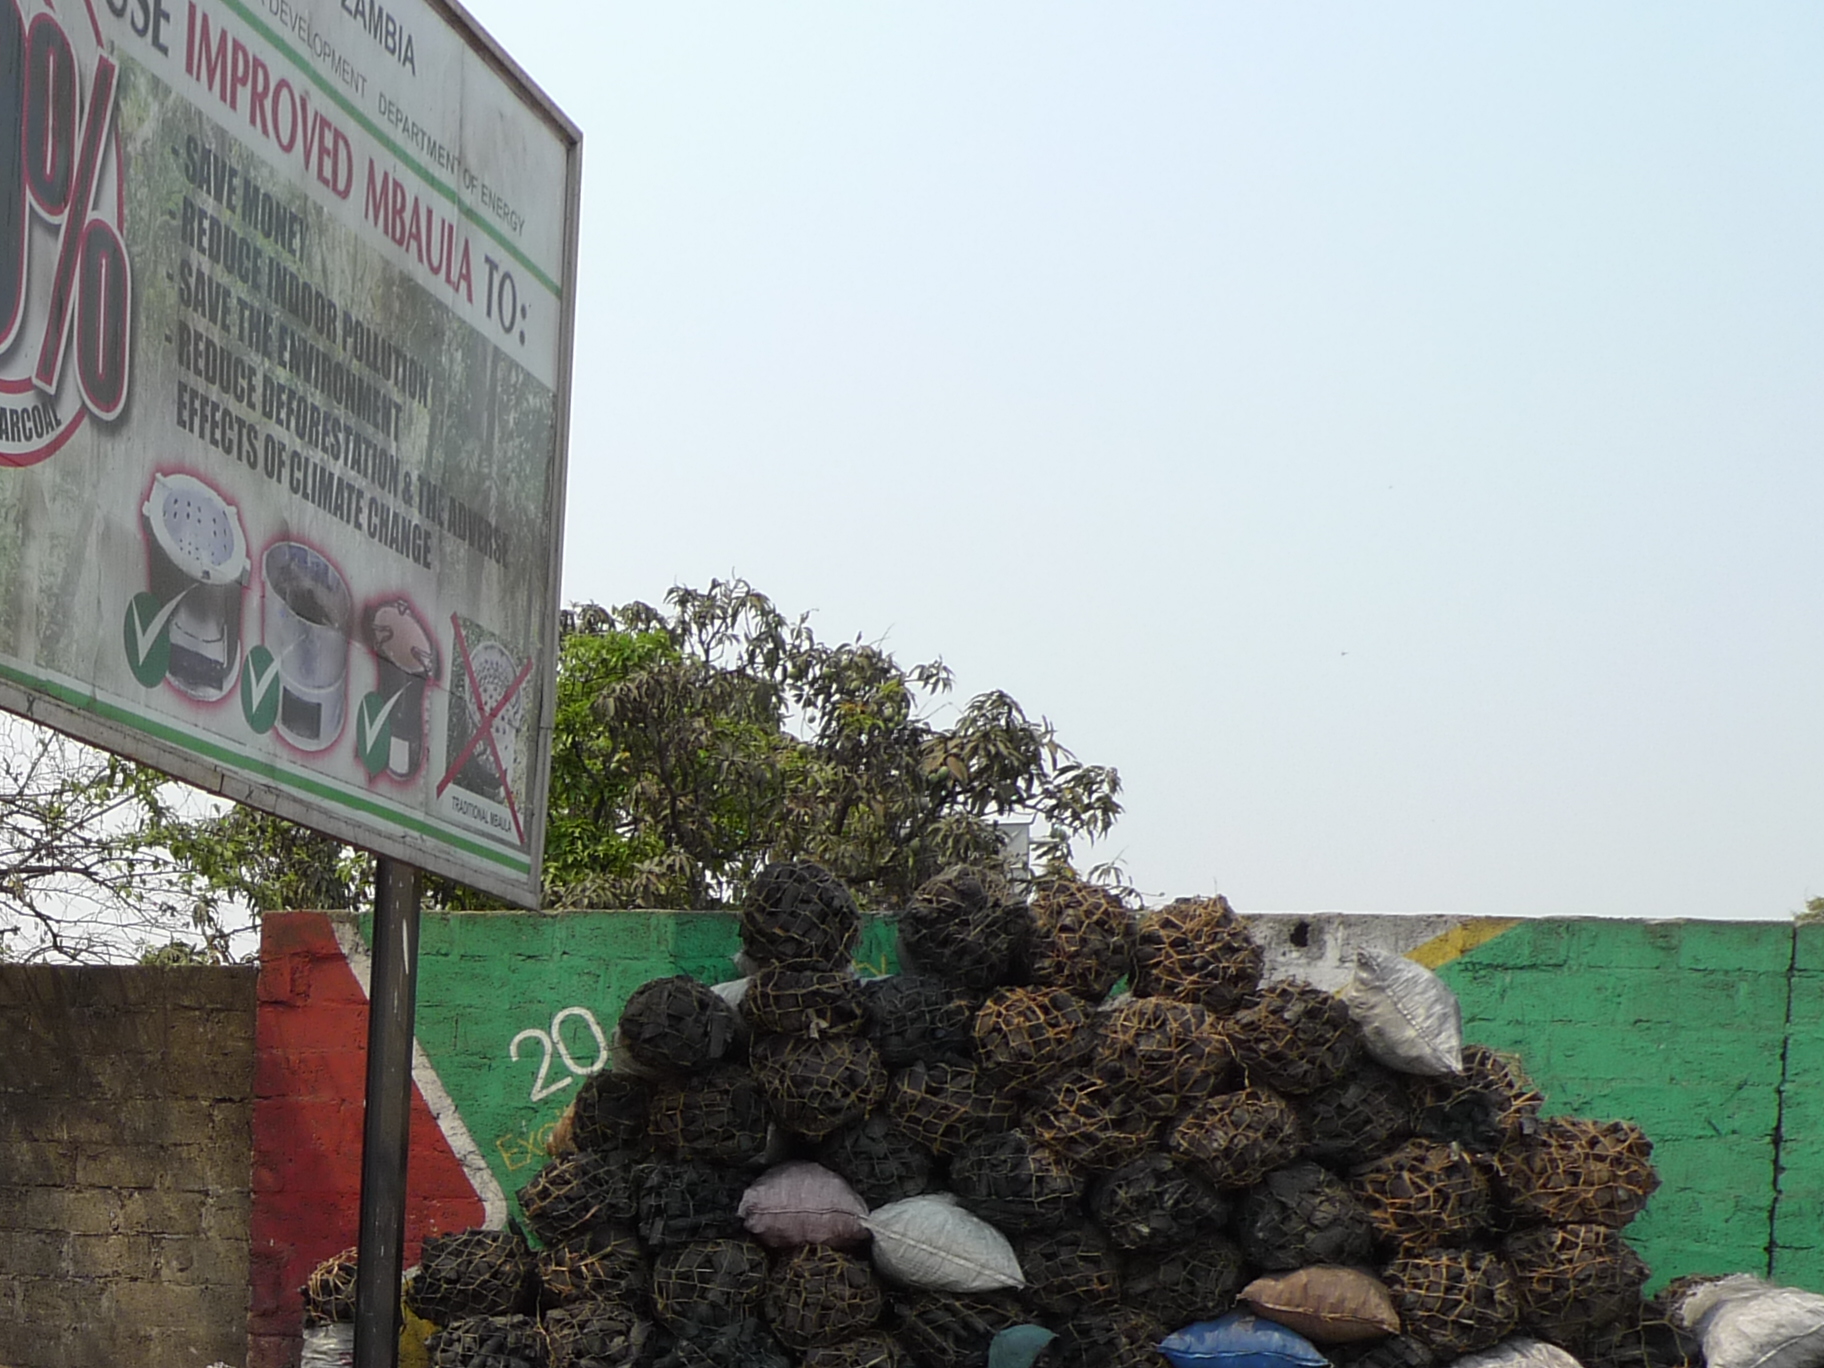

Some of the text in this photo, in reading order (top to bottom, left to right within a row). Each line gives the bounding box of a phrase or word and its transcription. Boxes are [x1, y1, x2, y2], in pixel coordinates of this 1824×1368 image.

[269, 0, 367, 98] DEVELOPMENT
[341, 0, 417, 76] AMBIA
[106, 0, 527, 346] SE IMPROVED MBAULA TO:
[184, 134, 308, 267] SAVE MONEY
[378, 93, 525, 238] DEPARTMENT OF ENERGY
[179, 259, 403, 443] SAVE THE ENVIRONMENT
[181, 196, 429, 409] REDUCE INDOOR POLLUTION
[176, 380, 432, 571] EFFECTS OF CLIMATE CHANGE
[178, 320, 508, 570] REDUCE DEFORESTATION & THE ADVERSE
[509, 1006, 609, 1102] 20
